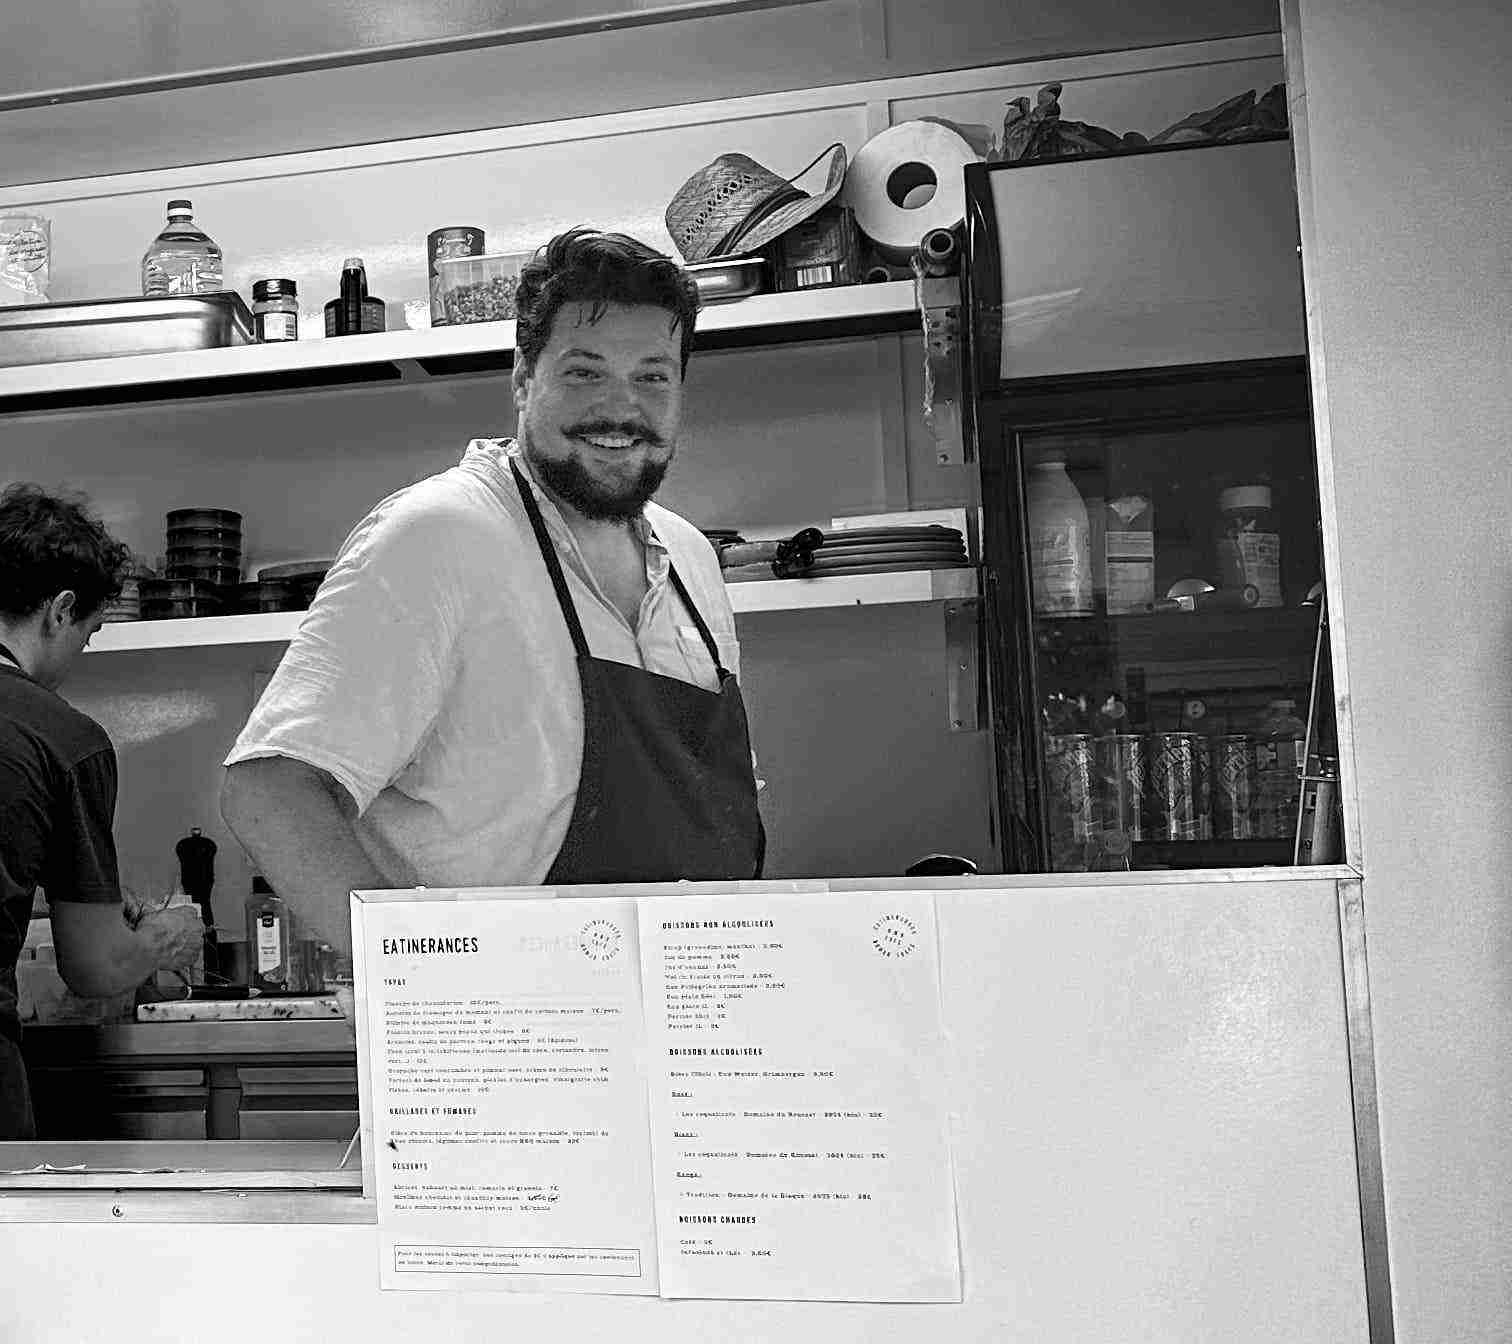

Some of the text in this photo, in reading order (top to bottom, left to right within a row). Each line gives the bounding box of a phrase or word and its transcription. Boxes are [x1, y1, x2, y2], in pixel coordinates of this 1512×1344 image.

[662, 921, 700, 929] BOISSONS
[703, 920, 719, 929] NON
[383, 937, 478, 954] EATINERANCES
[669, 1048, 707, 1056] BOISSONS
[431, 1107, 440, 1115] ET
[392, 1162, 428, 1171] DESSERTS
[679, 1215, 757, 1224] BOISSONS CHAUDES
